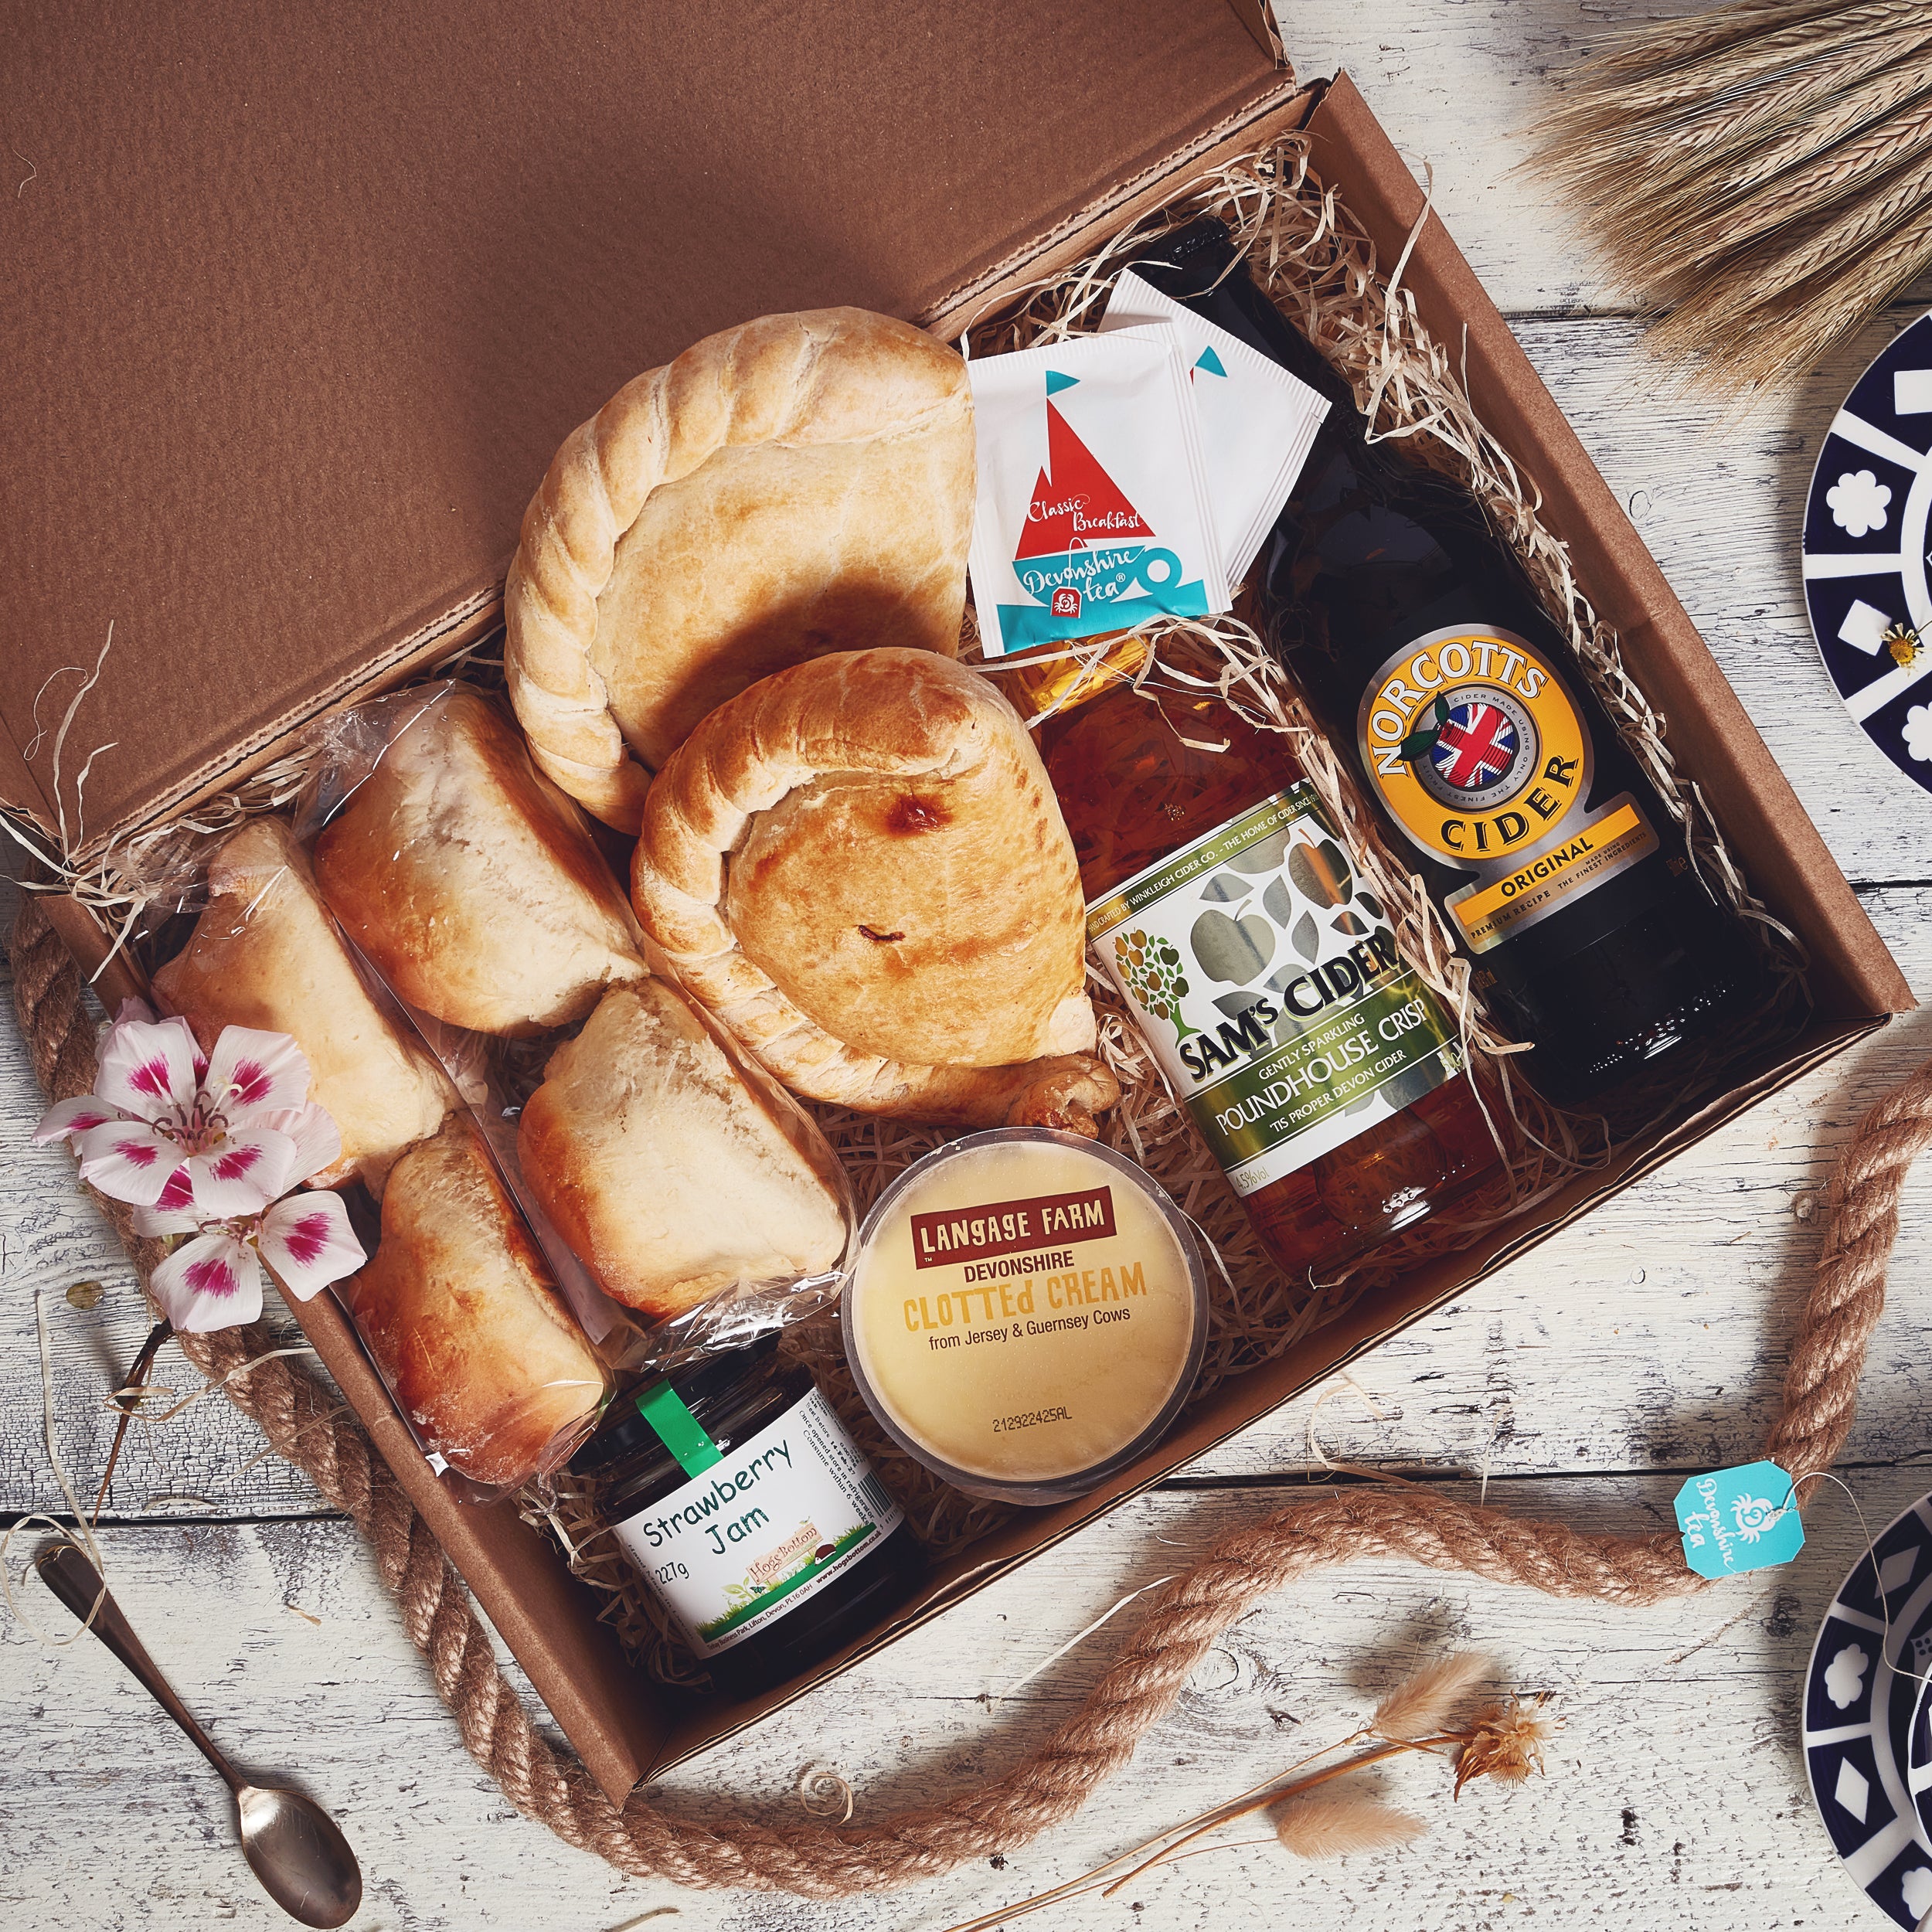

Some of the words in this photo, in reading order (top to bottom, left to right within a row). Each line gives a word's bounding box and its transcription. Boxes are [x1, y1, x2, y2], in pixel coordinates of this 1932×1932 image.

[1027, 494, 1090, 522] Classic
[1073, 511, 1144, 531] Breakfast
[1022, 546, 1146, 597] Devonshire
[1371, 641, 1549, 779] NORCOTTS
[1454, 693, 1487, 703] CIDER
[1492, 696, 1518, 716] MADE
[1518, 719, 1530, 750] USING
[1422, 764, 1443, 791] FRUIT
[1491, 784, 1510, 798] THE
[1513, 757, 1528, 782] ONLY
[1440, 754, 1580, 852] CIDER
[1447, 791, 1485, 802] FINEST
[1121, 900, 1131, 912] BY
[1129, 874, 1175, 906] WINKLEIGH
[1175, 859, 1202, 879] CIDER
[1200, 851, 1219, 864] CO.
[1222, 835, 1242, 851] THE
[1240, 821, 1267, 842] HOME
[1267, 816, 1277, 826] OF
[1277, 804, 1298, 820] CIDER
[1296, 796, 1311, 811] SINCE
[1501, 837, 1594, 897] ORIGINAL
[1557, 877, 1573, 889] THE
[1576, 859, 1602, 879] FINEST
[1604, 832, 1646, 862] INGREDIENTS
[1585, 853, 1602, 865] MADE
[1603, 842, 1621, 855] USING
[1471, 913, 1511, 939] PREMIUM
[1513, 890, 1550, 916] RECIPE
[1283, 934, 1400, 1022] CIDER
[1215, 1029, 1379, 1136] POUNDHOUSE
[1378, 998, 1429, 1042] CRISP
[1258, 1050, 1300, 1080] GENTLY
[1302, 1012, 1366, 1056] SPARKLING
[1269, 1117, 1289, 1134] 'TIS
[1288, 1092, 1335, 1122] PROPER
[1332, 1068, 1376, 1099] DEVON
[1374, 1049, 1407, 1073] CIDER
[1041, 1199, 1105, 1235] FARM
[964, 1250, 1075, 1283] DEVONSHIRE
[1046, 1261, 1148, 1310] CREAM
[928, 1333, 961, 1351] from
[964, 1326, 1008, 1346] Jersey
[1012, 1322, 1023, 1338] &
[1026, 1314, 1089, 1335] Guernsey
[1093, 1307, 1131, 1325] Cows
[805, 1402, 817, 1417] Best
[815, 1416, 831, 1439] Before
[830, 1440, 855, 1476] 14-Feb-27
[992, 1406, 1073, 1434] 212922425AL
[799, 1410, 813, 1429] Once
[811, 1429, 831, 1455] opened
[829, 1454, 842, 1471] store
[841, 1471, 848, 1480] in
[643, 1439, 792, 1547] Strawberry
[803, 1430, 829, 1467] Consume
[828, 1468, 847, 1493] within
[851, 1501, 869, 1526] weeks
[705, 1507, 770, 1554] Jam
[1684, 1511, 1709, 1549] tea
[1696, 1478, 1737, 1573] Devonshire
[655, 1562, 689, 1584] 227g
[815, 1530, 882, 1584] www.hogsbottom.co.uk
[718, 1633, 738, 1647] Business
[736, 1624, 750, 1638] Park,
[748, 1615, 767, 1632] Lifton,
[765, 1604, 787, 1620] Devon,
[784, 1591, 801, 1606] PL16
[799, 1583, 814, 1596] 0AH
